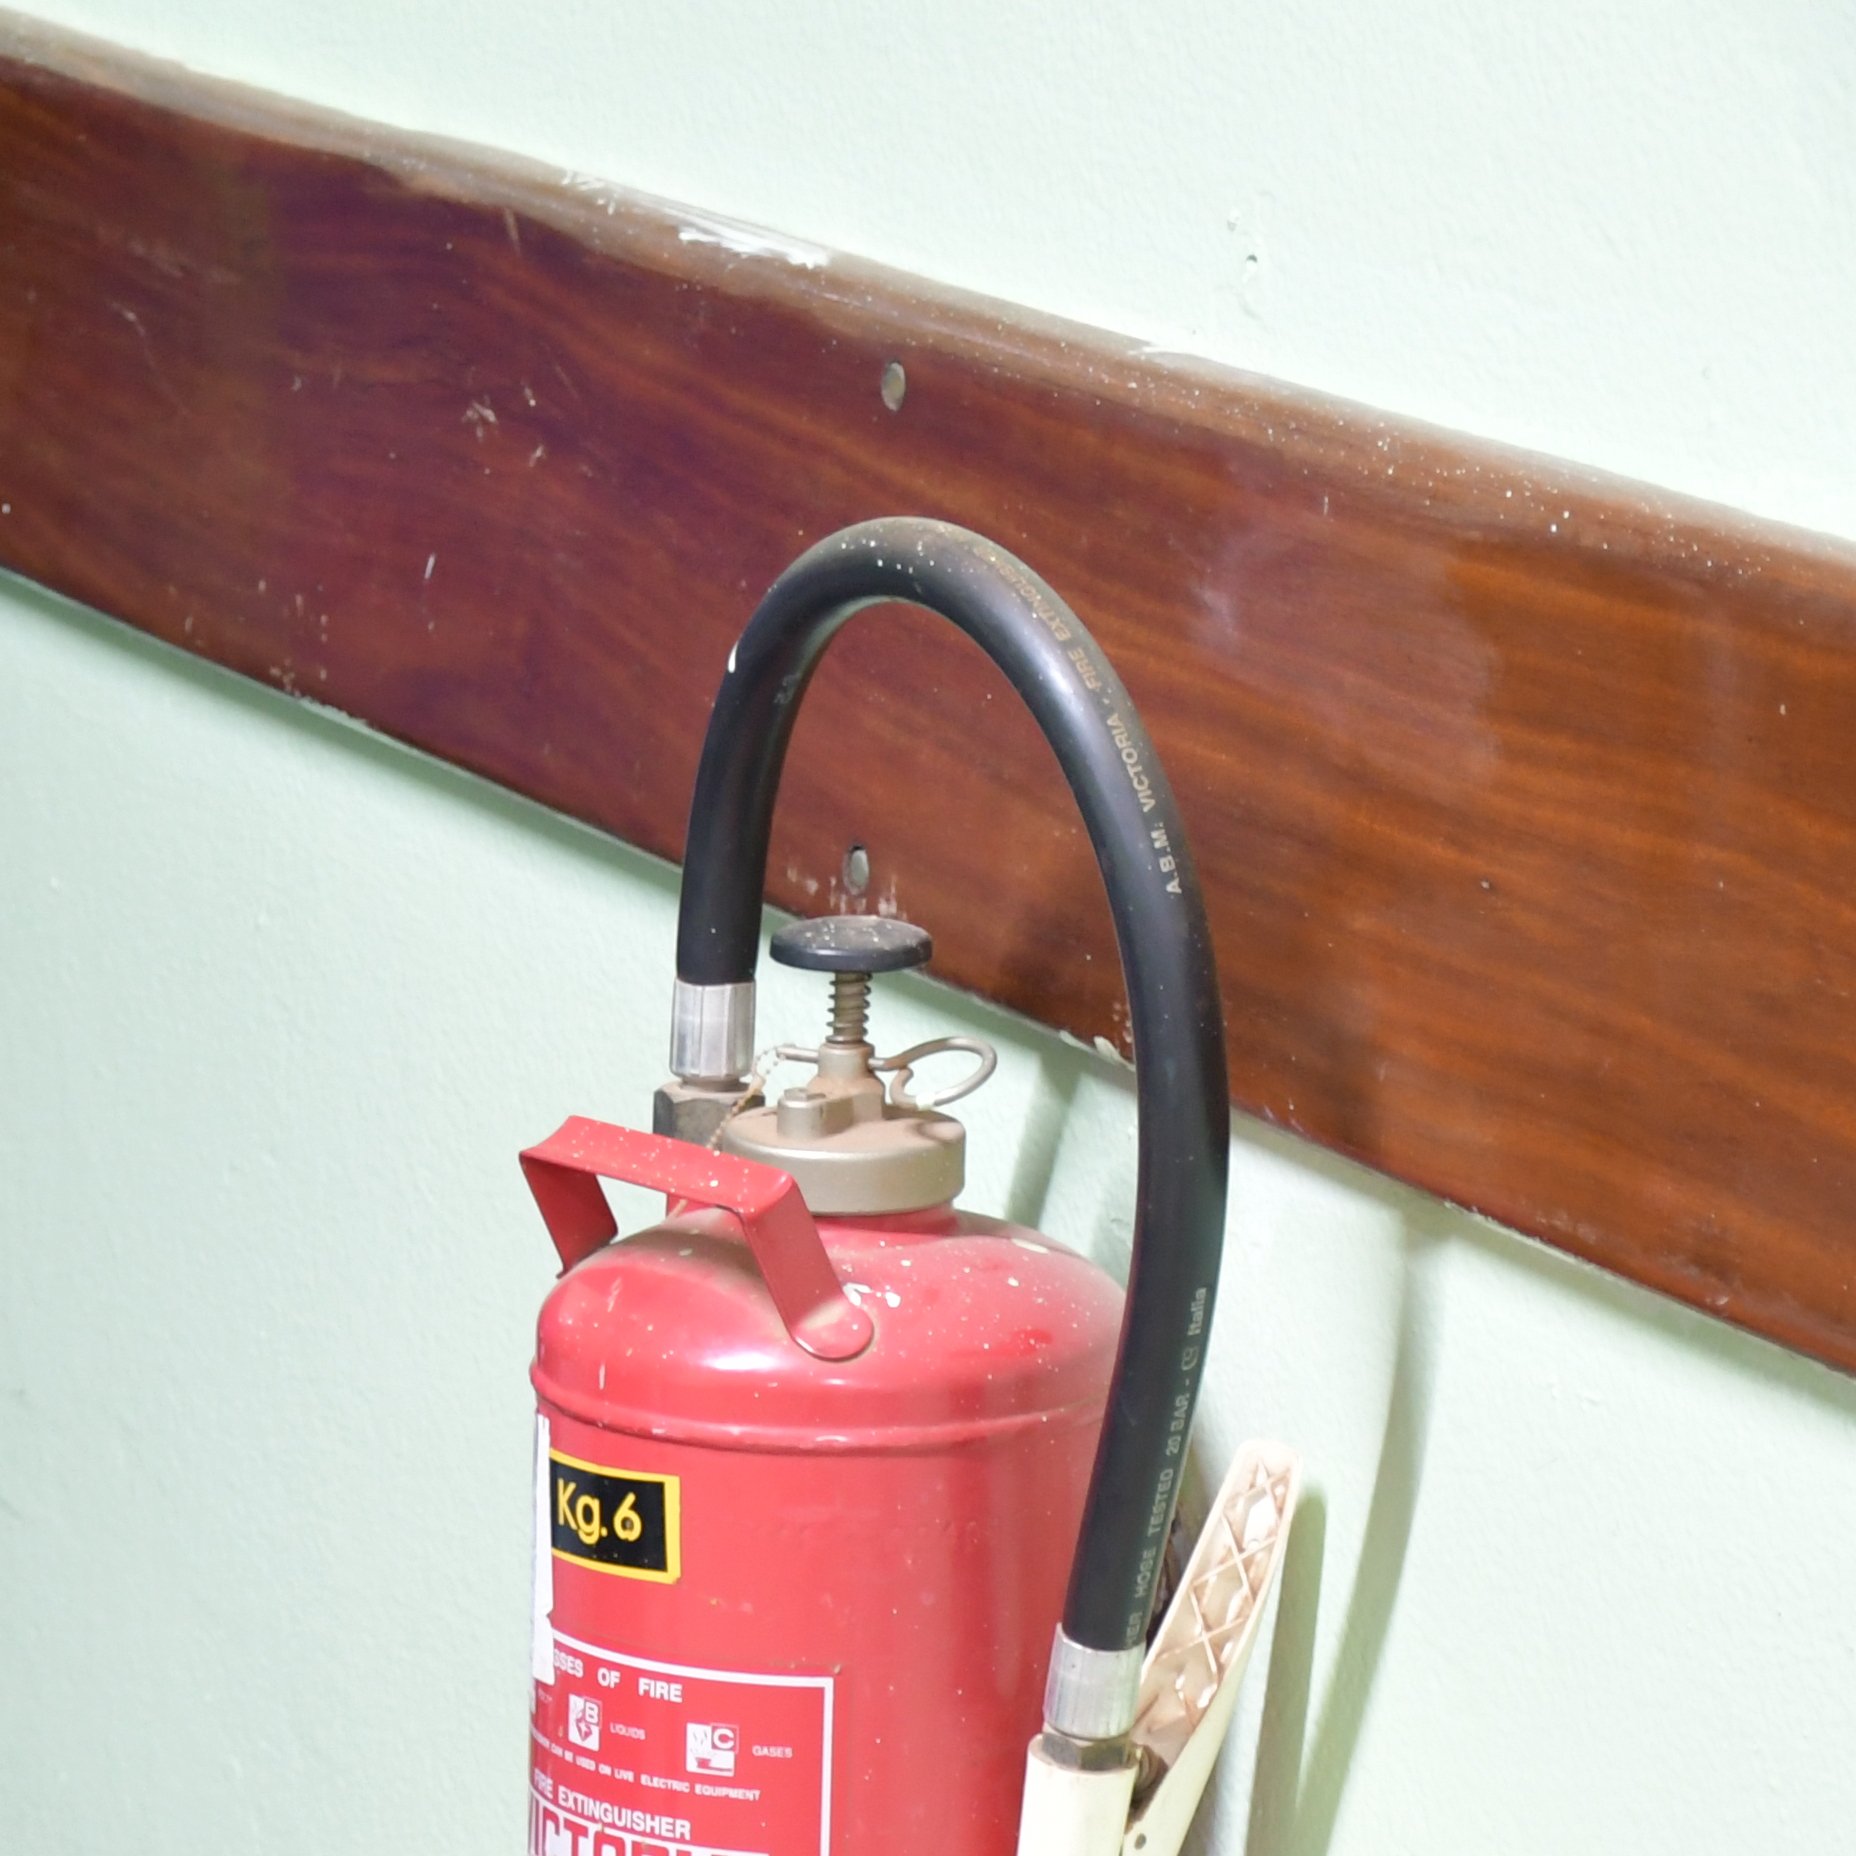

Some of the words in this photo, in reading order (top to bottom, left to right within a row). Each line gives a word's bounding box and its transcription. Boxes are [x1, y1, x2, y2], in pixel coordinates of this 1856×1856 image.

[1067, 648, 1103, 691] FIRE
[1106, 712, 1157, 813] VICTORIA
[1147, 1467, 1174, 1538] TESTED
[1186, 1286, 1208, 1337] Italia
[597, 1666, 621, 1689] OF
[638, 1676, 683, 1703] FIRE
[751, 1744, 794, 1759] GASES
[614, 1767, 635, 1783] LIVE
[640, 1772, 691, 1793] ELECTRIC
[694, 1782, 761, 1801] EQUIPMENT
[557, 1785, 692, 1841] EXTINGUISHER
